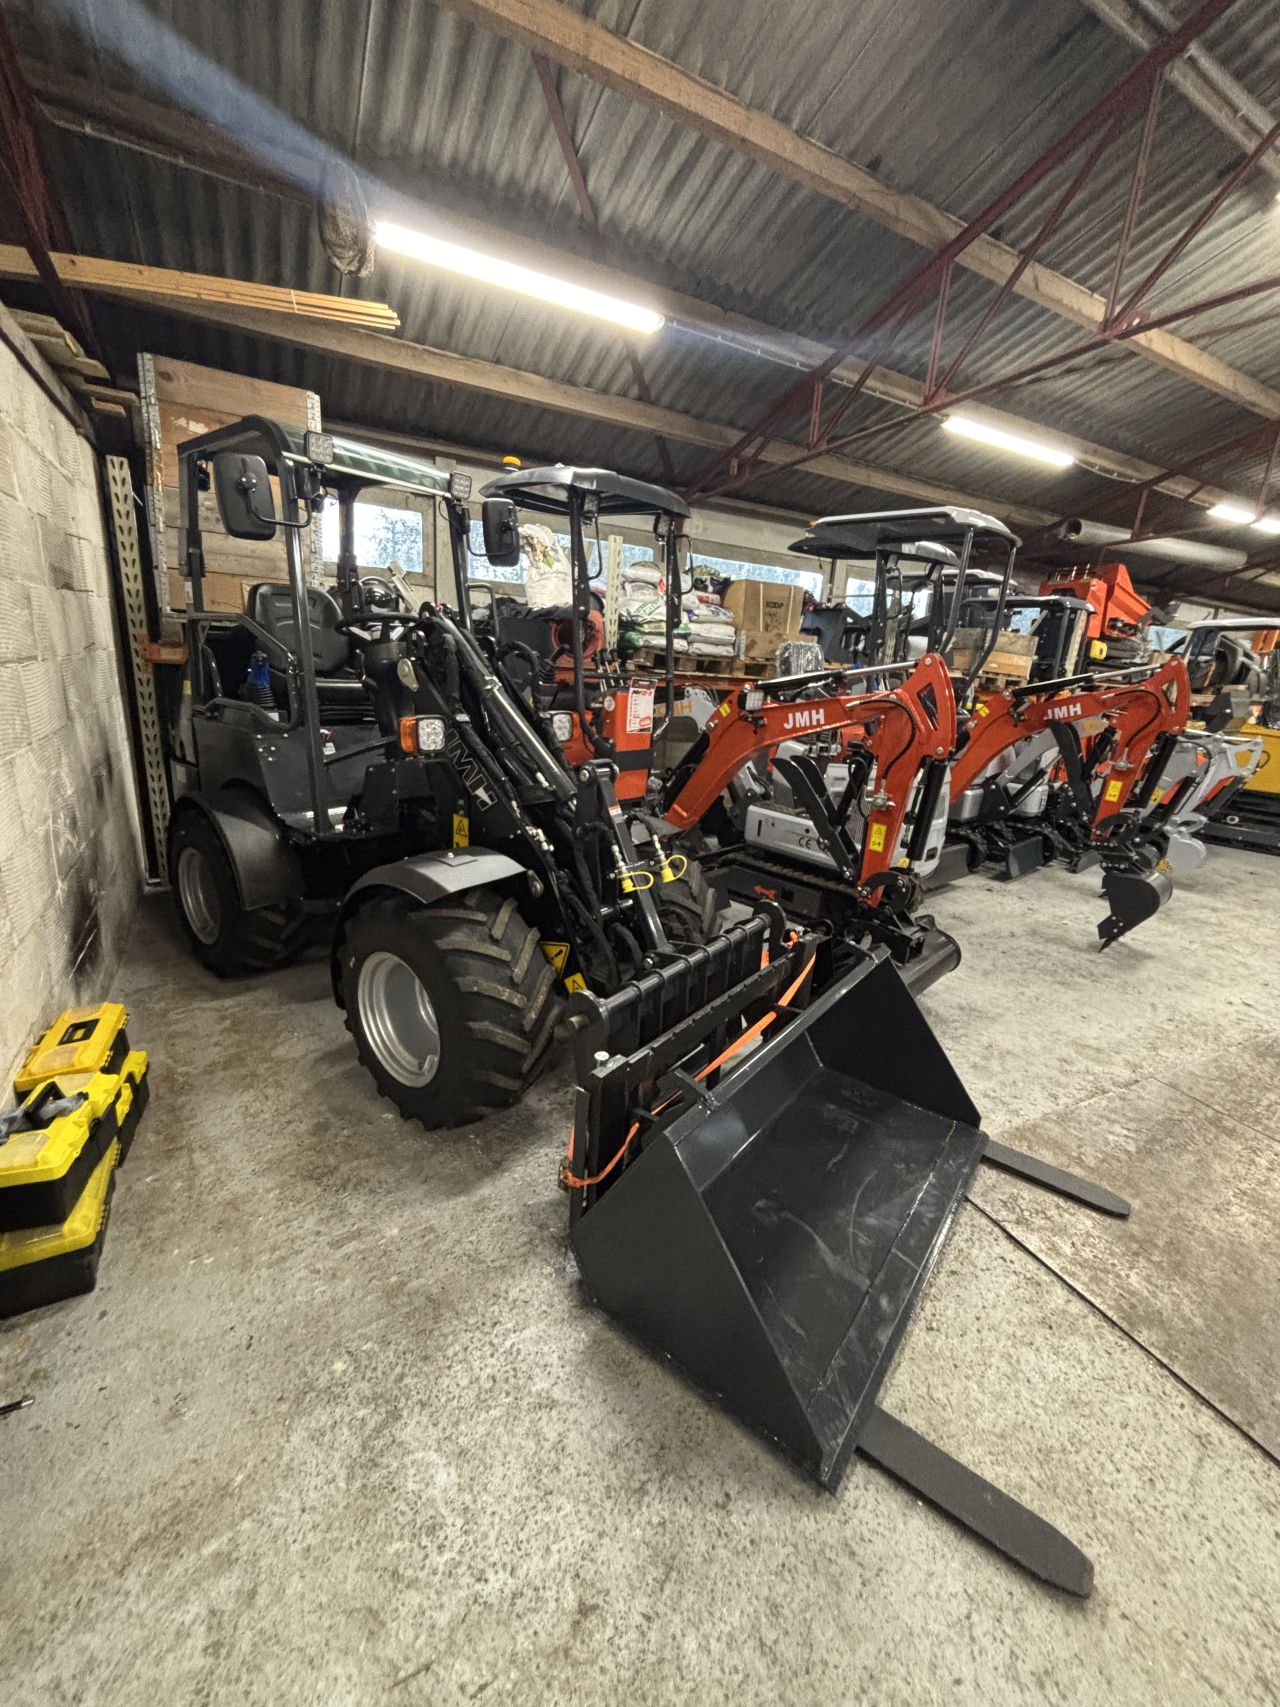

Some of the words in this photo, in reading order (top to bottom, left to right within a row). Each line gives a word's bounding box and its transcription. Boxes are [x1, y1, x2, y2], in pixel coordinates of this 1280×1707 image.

[783, 708, 825, 729] JMH
[1043, 702, 1082, 720] JMH
[798, 837, 812, 850] CE
